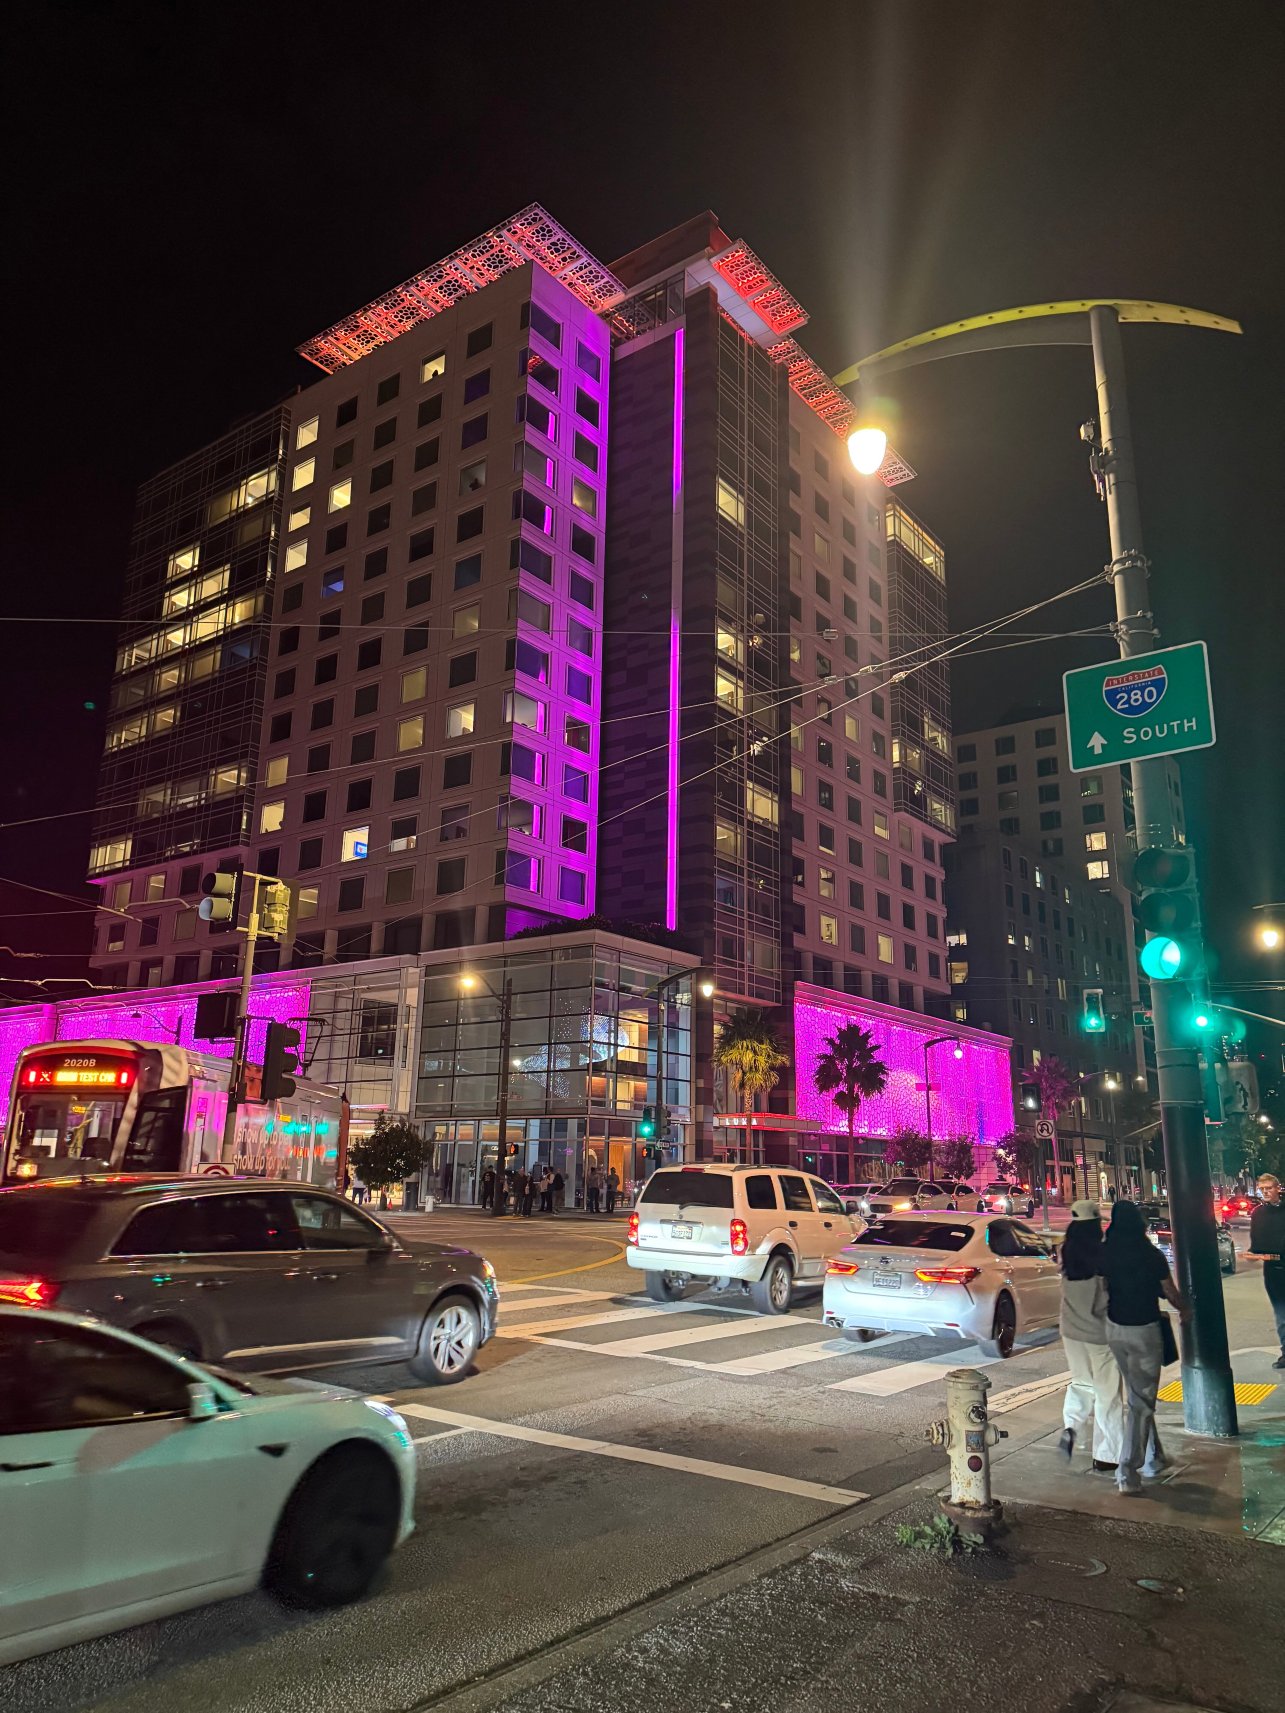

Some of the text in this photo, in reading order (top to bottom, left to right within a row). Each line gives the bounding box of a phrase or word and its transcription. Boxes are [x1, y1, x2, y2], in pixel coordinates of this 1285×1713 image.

[1109, 669, 1160, 686] INTERSTATE
[1118, 681, 1151, 692] CALIFORNIA
[1116, 686, 1157, 710] 280
[1123, 717, 1197, 744] SOUTH
[63, 1058, 97, 1067] 2020B
[79, 1072, 99, 1082] TEST
[236, 1126, 259, 1144] show
[233, 1152, 254, 1171] show
[255, 1156, 265, 1175] up
